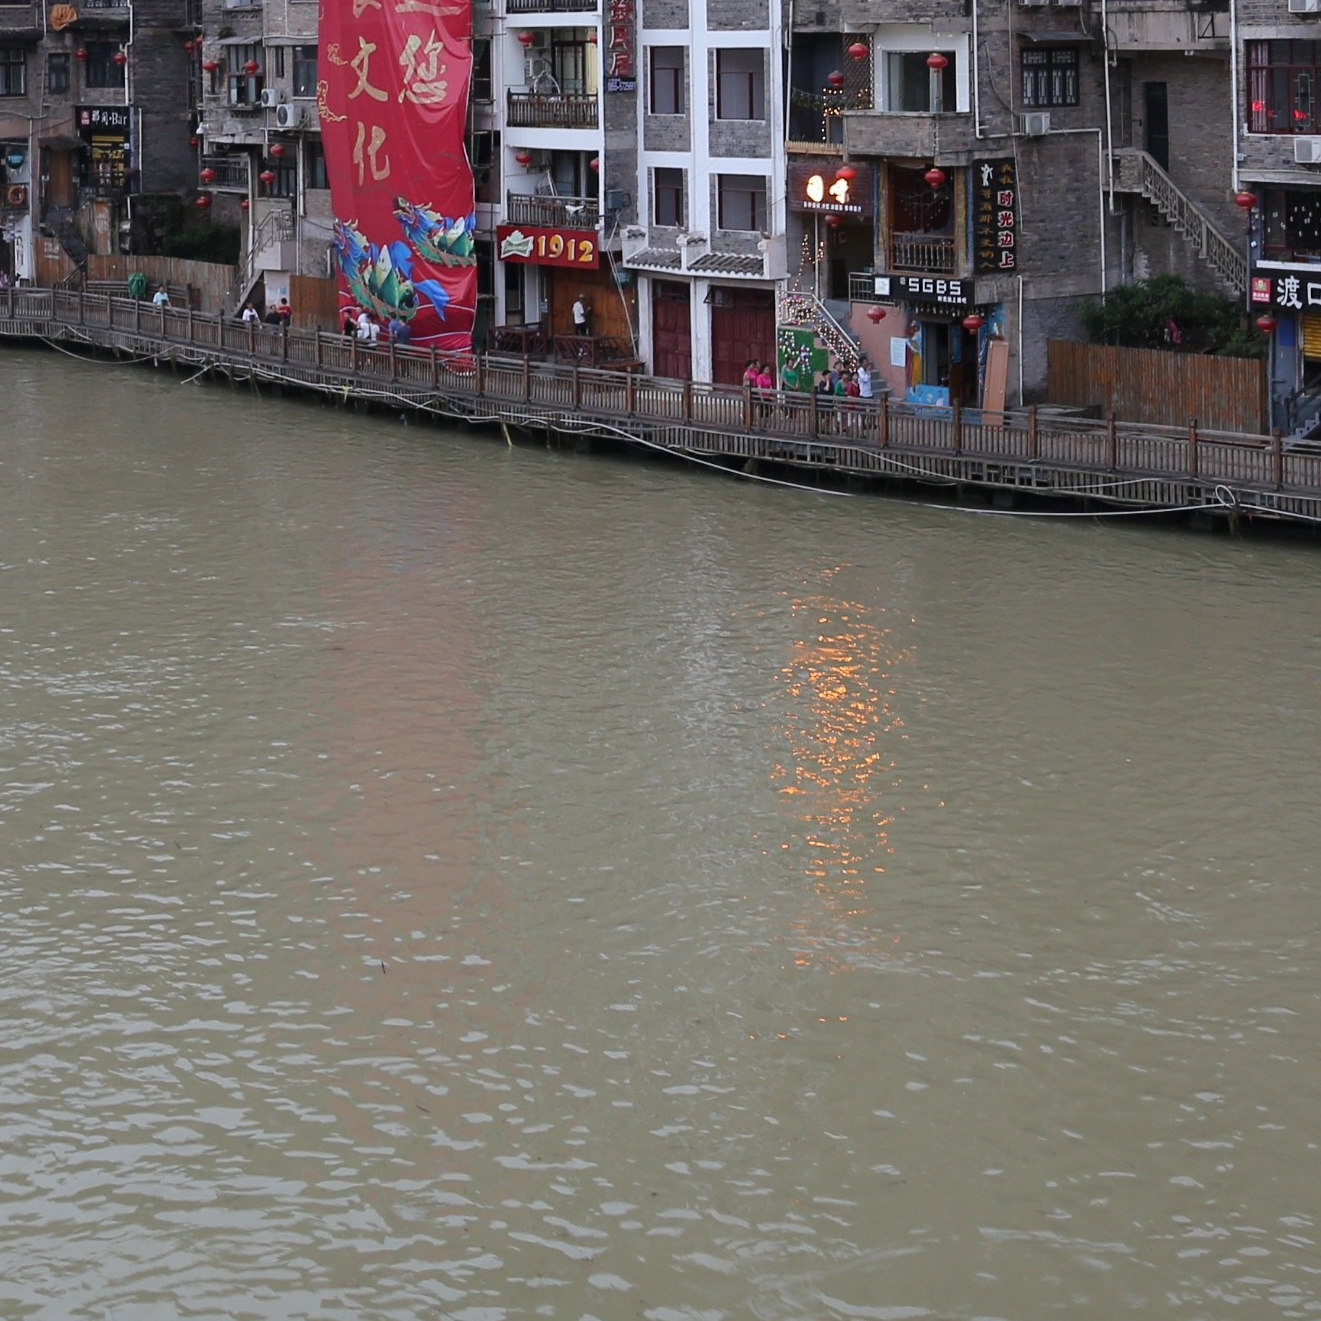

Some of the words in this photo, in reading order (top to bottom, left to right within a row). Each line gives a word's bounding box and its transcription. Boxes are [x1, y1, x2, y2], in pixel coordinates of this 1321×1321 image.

[998, 190, 1014, 268] 时光边上
[538, 234, 593, 263] 1912
[908, 277, 961, 296] SGBS
